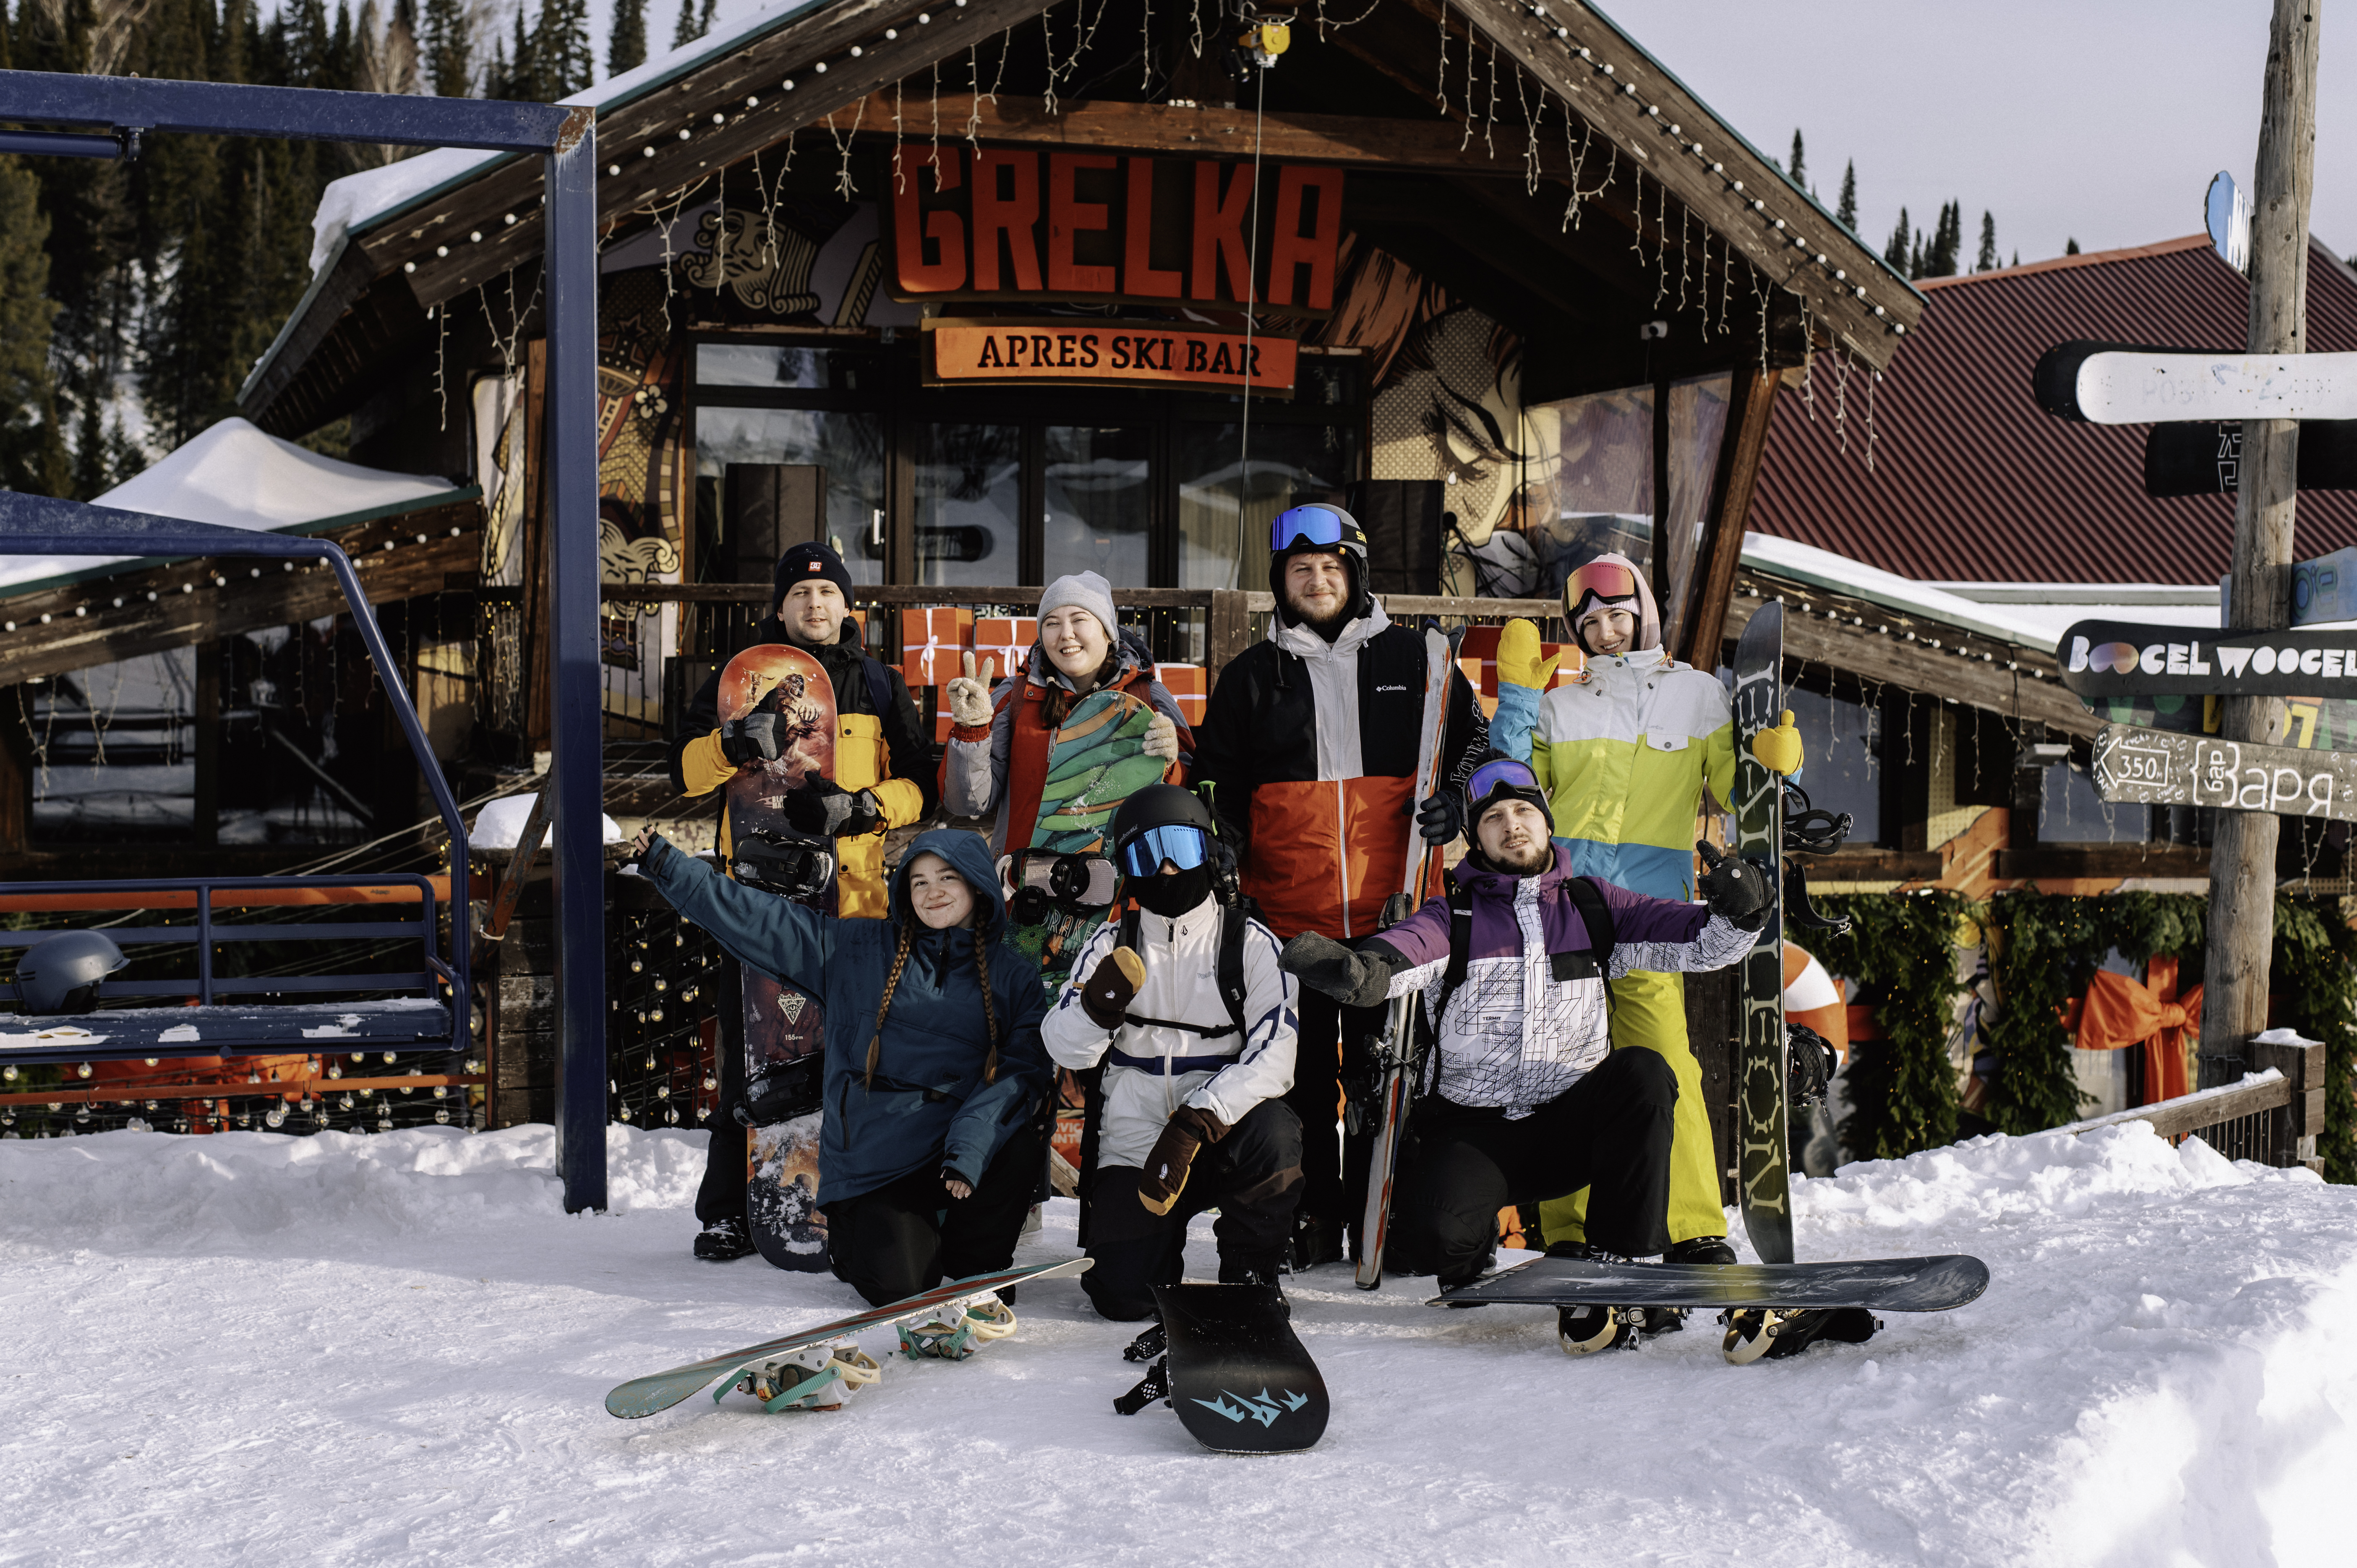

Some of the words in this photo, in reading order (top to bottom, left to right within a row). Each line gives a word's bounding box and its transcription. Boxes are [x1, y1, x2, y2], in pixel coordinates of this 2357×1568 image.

[893, 145, 1343, 310] GRELKA
[977, 335, 1099, 369] APRES
[1111, 336, 1173, 371] SKI
[1184, 339, 1261, 377] BAR
[1052, 934, 1084, 955] VENIC
